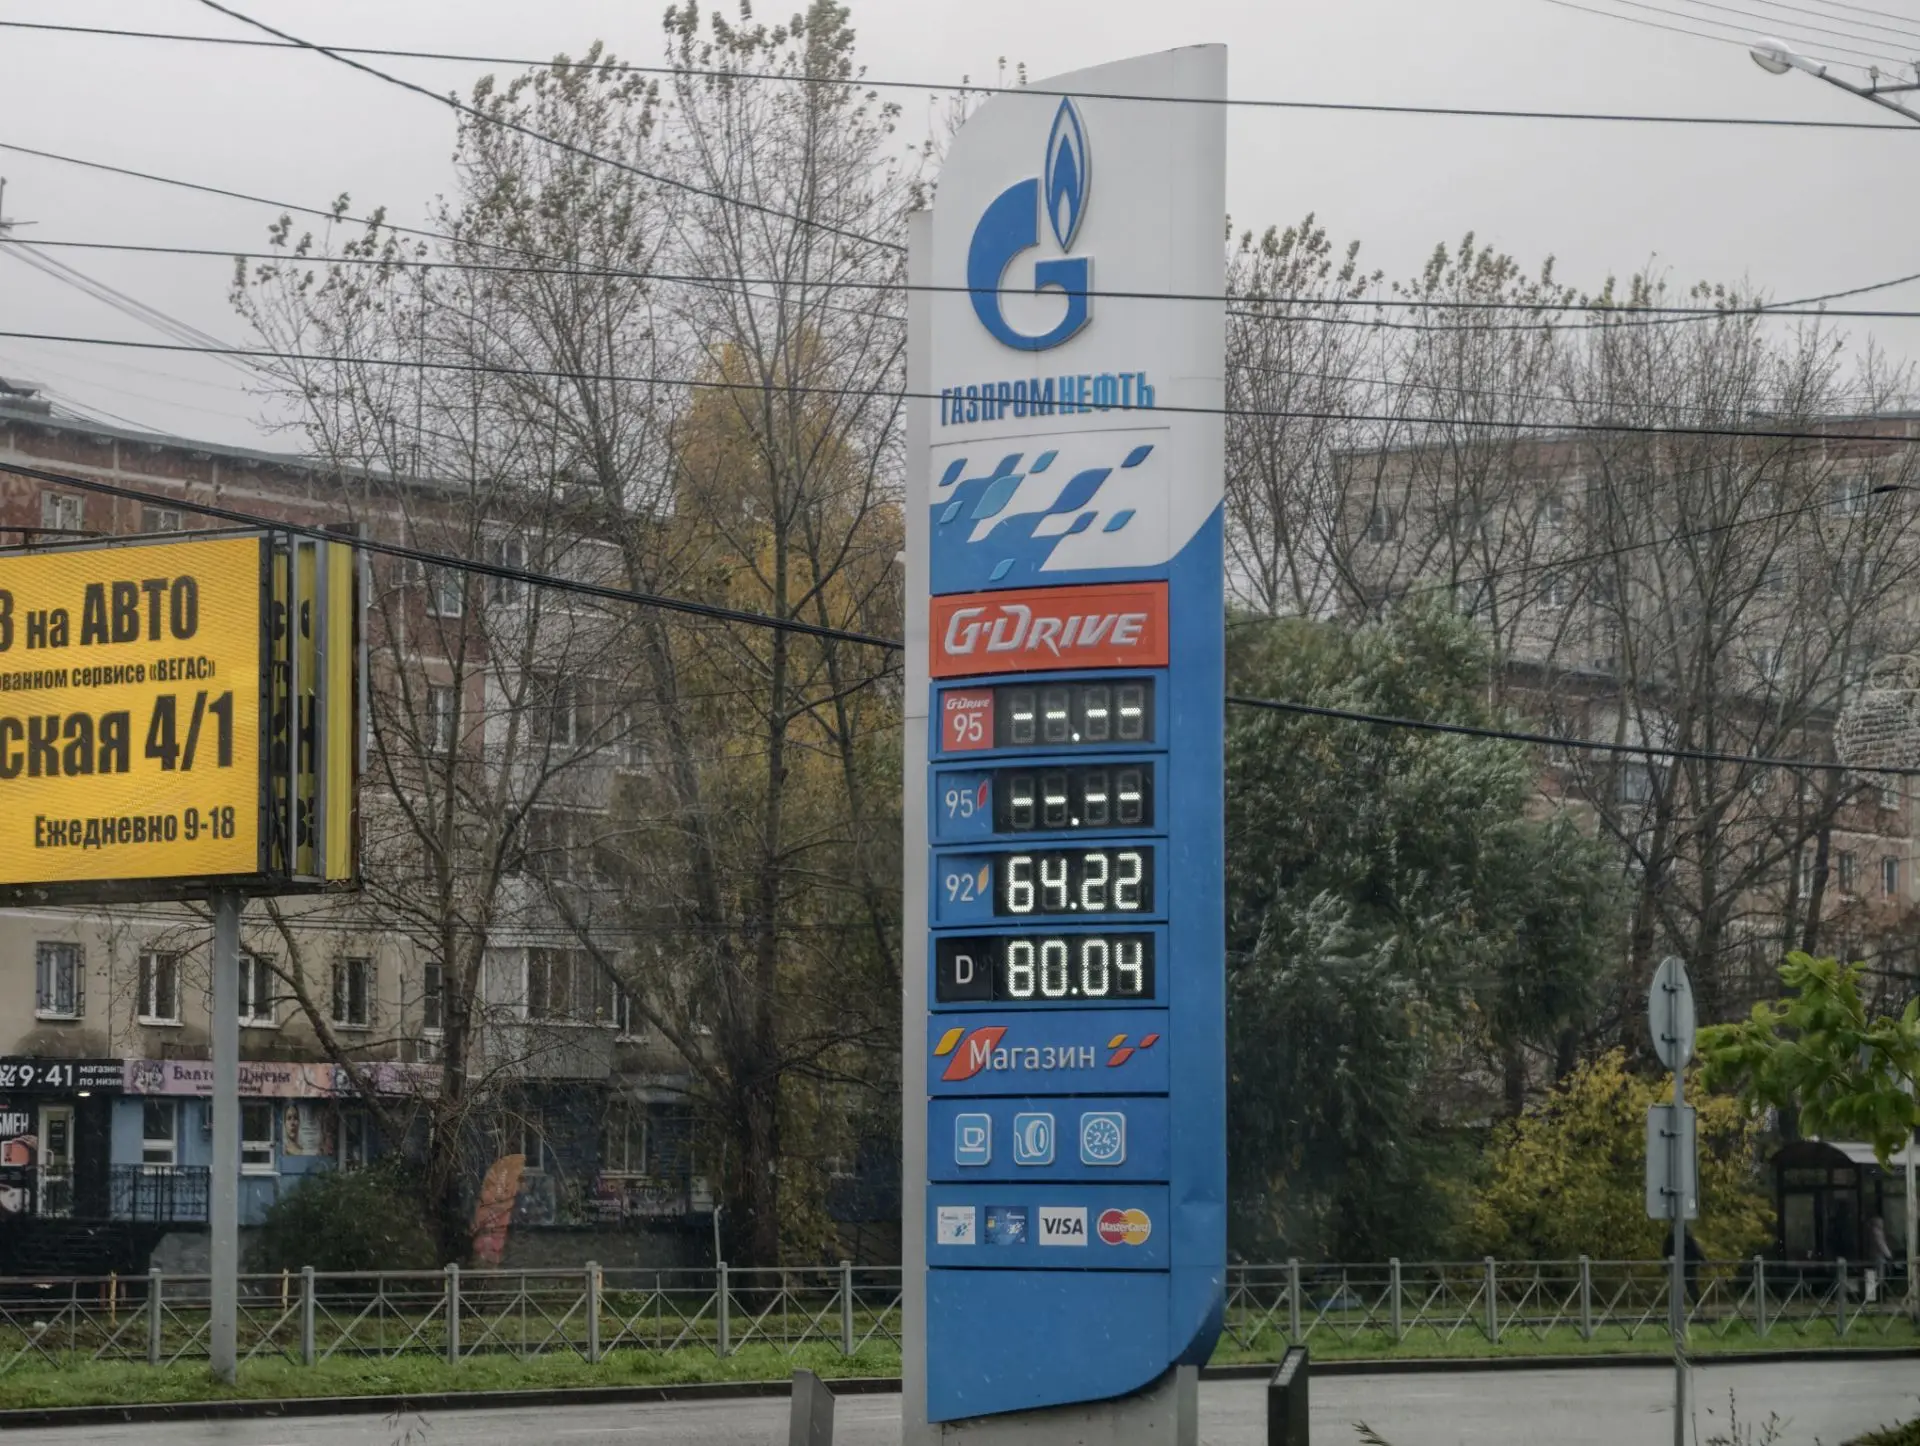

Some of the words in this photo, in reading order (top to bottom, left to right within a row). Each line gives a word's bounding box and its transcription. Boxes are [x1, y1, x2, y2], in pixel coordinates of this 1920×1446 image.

[941, 371, 1155, 426] ГАЗПРОМНЕФТЬ
[26, 607, 69, 649] на
[80, 575, 199, 646] АВТО
[0, 669, 68, 691] ванном
[72, 664, 146, 689] сервисе
[150, 656, 215, 681] «ВЕГАС»
[144, 690, 234, 772] 4/1
[953, 712, 983, 742] 95
[945, 789, 974, 818] 95
[34, 812, 178, 850] Ежедневно
[183, 806, 235, 842] 9-18
[946, 874, 974, 902] 92
[1008, 853, 1142, 912] 64.22
[955, 954, 974, 984] D
[1008, 939, 1142, 997] 80.04
[970, 1039, 1096, 1071] Магазин
[0, 1112, 29, 1137] МЕН
[1094, 1131, 1111, 1146] 24
[1042, 1217, 1084, 1235] VISA
[1101, 1222, 1148, 1233] MasterCard
